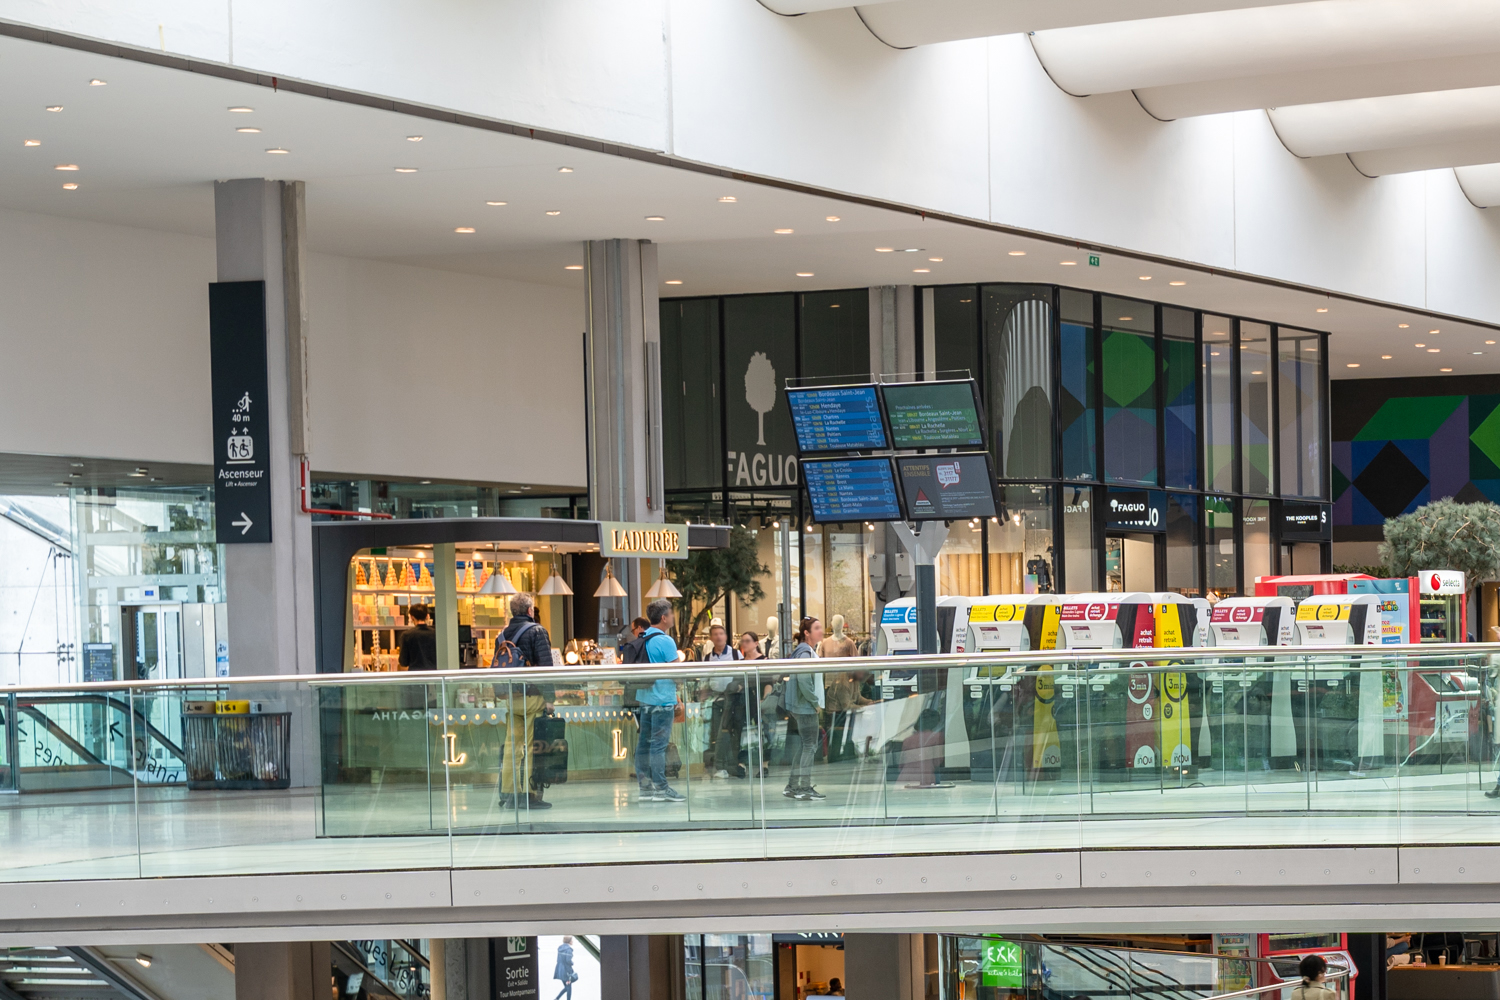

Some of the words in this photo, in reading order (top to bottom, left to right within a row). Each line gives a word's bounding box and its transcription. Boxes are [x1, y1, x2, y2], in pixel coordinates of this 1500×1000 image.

[232, 414, 241, 422] 40
[219, 469, 263, 479] Ascenseur
[728, 451, 798, 486] FAGUO
[612, 529, 679, 552] LADURÉE
[1443, 579, 1460, 587] selecta
[442, 733, 466, 764] L
[613, 730, 627, 758] L
[506, 966, 529, 980] Sortie
[509, 989, 536, 997] Montparnasse
